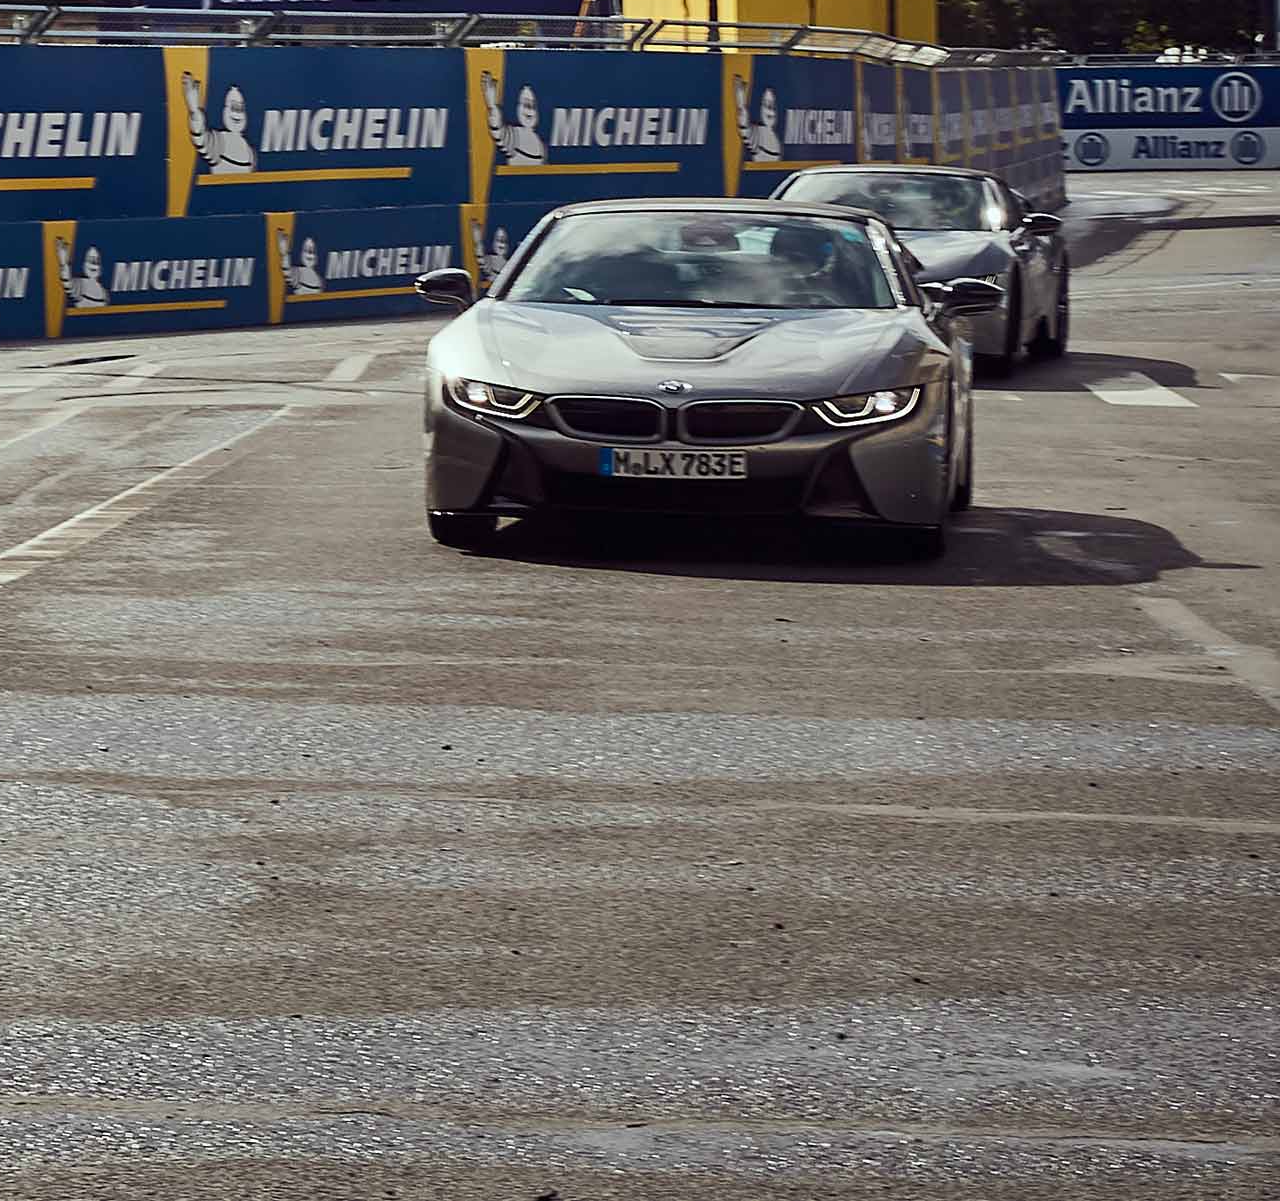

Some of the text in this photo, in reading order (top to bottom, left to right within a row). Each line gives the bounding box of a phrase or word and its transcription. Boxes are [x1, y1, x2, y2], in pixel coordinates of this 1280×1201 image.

[1064, 78, 1203, 114] Allianz
[260, 107, 448, 153] MICHELIN
[550, 107, 709, 147] MICHELIN
[1132, 135, 1227, 160] Allianz
[112, 257, 255, 292] MICHELIN
[325, 244, 452, 279] MICHELIN
[681, 453, 747, 476] 783E
